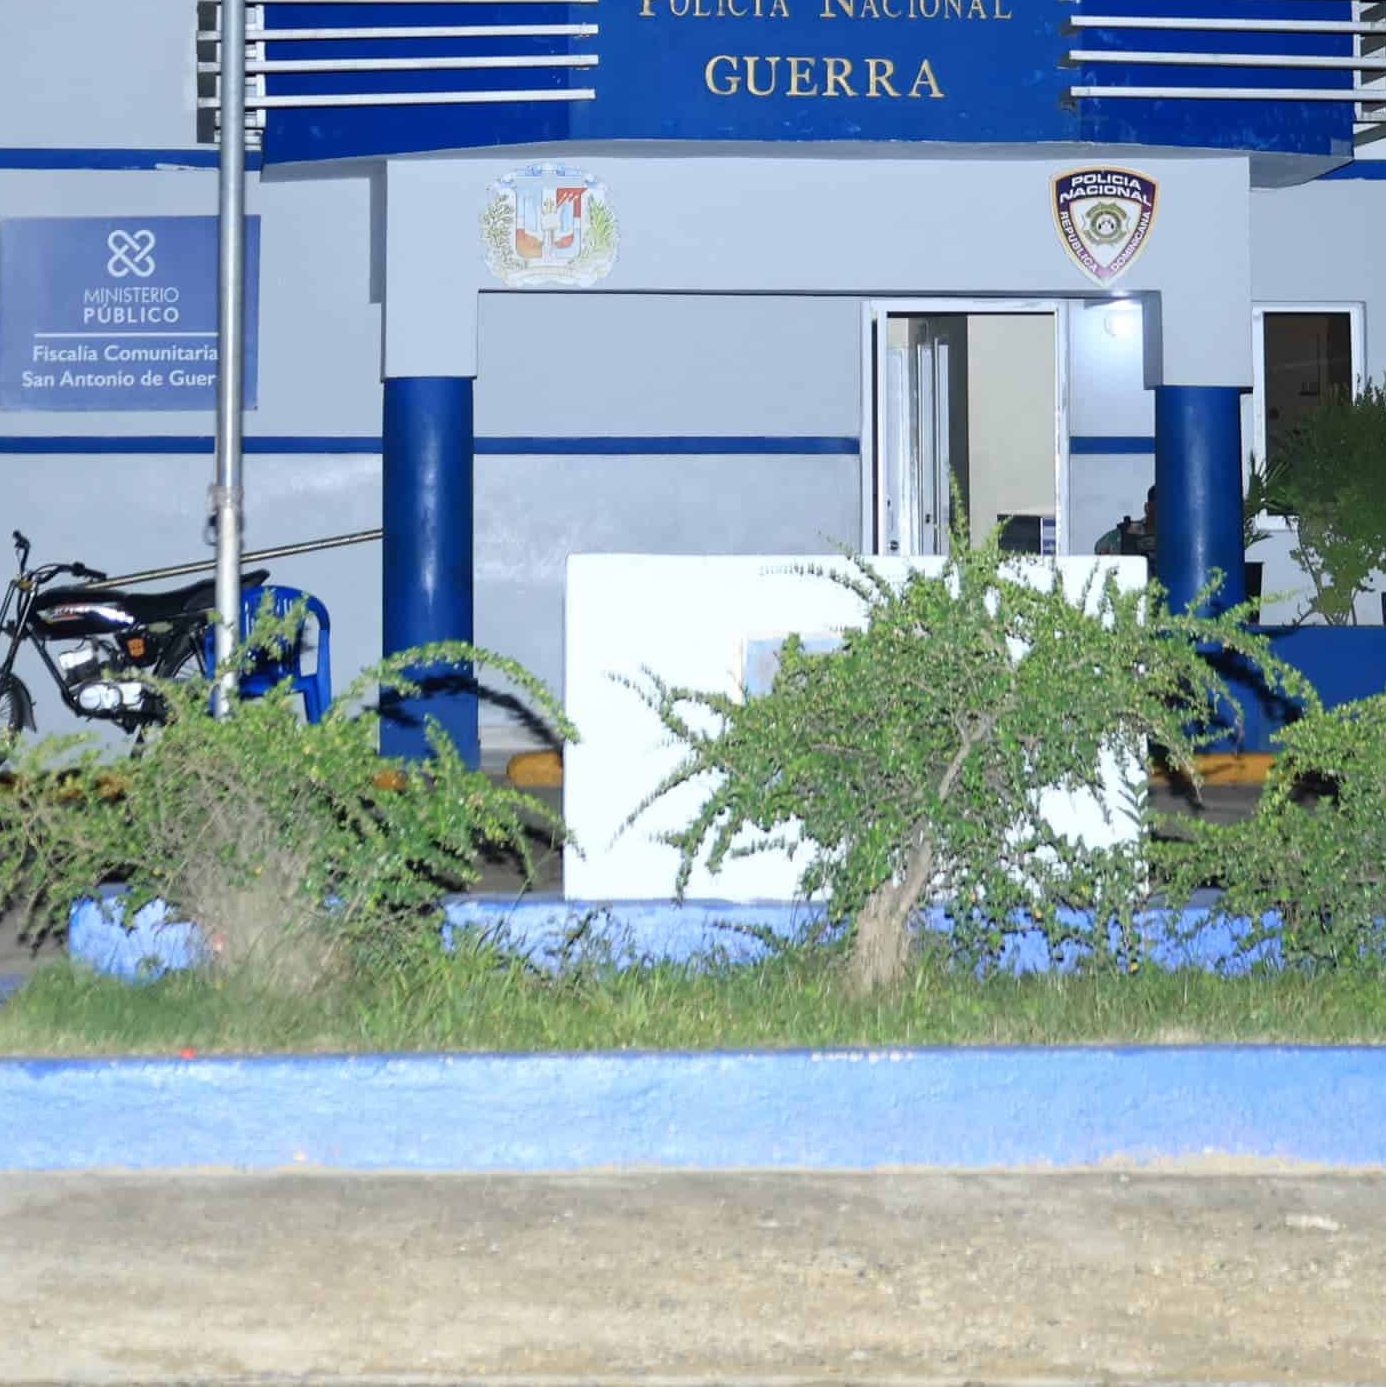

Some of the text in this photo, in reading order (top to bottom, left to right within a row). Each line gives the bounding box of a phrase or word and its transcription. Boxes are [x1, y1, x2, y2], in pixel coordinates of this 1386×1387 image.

[704, 54, 945, 99] GUERRA
[1071, 173, 1142, 191] POLICIA
[1059, 185, 1152, 207] NACIONAL
[1059, 210, 1099, 273] REPUBLICA
[83, 286, 180, 304] MINISTERIO
[83, 303, 180, 325] PÚBLICO
[103, 344, 219, 362] Comunitaria
[21, 369, 217, 388] San Antonio de Guer
